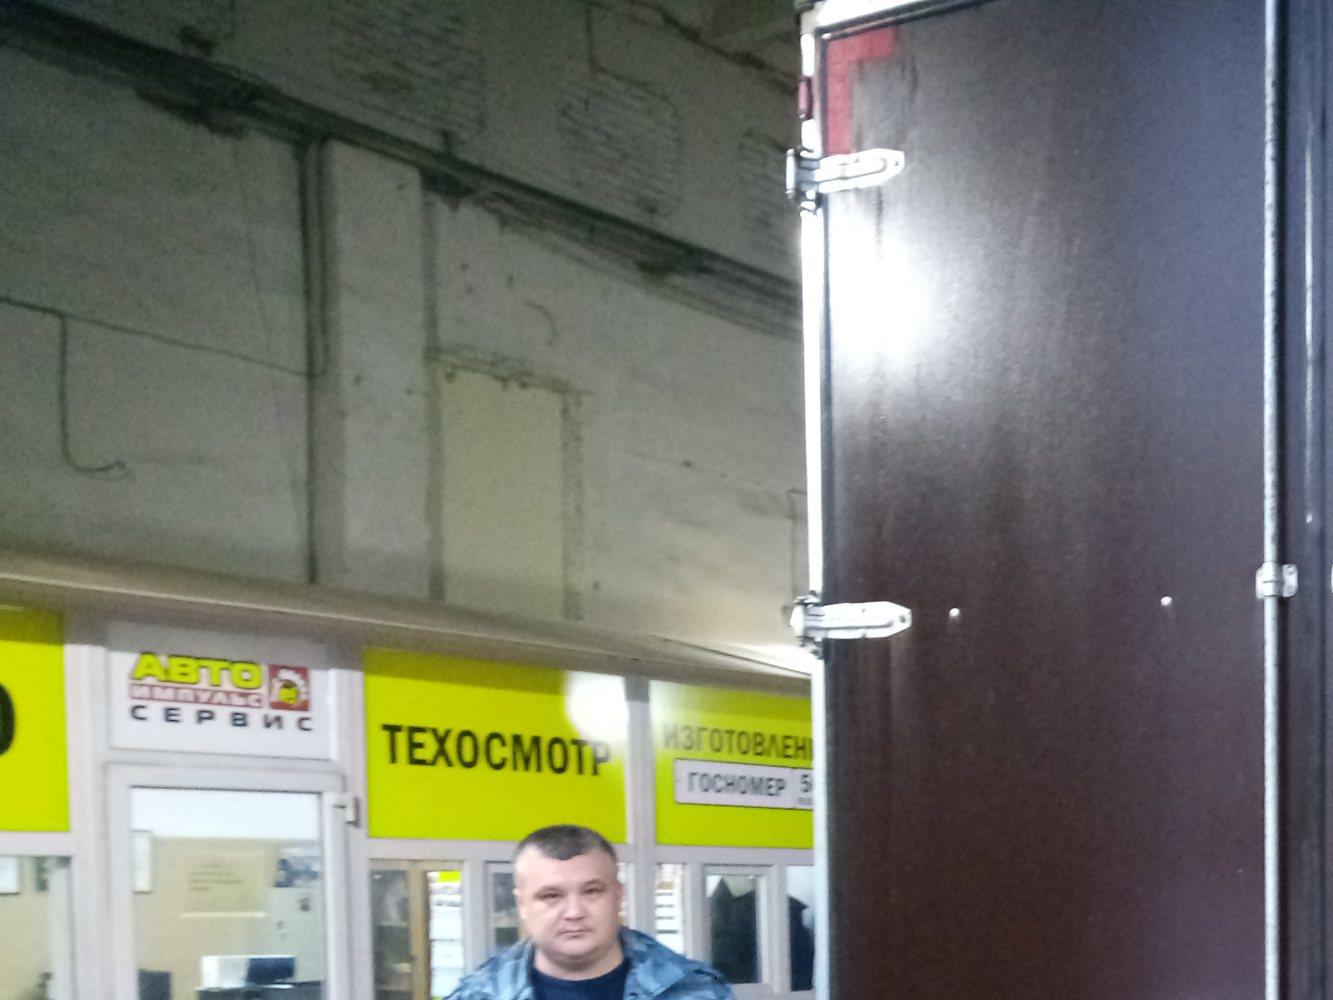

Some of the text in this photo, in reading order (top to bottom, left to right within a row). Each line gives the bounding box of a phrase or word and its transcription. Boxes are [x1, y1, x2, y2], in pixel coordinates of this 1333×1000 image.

[131, 652, 262, 689] АВТО
[131, 705, 312, 731] СЕРВИС
[381, 724, 611, 776] ТЕХОСМОТР
[663, 724, 812, 761] ИЗГОТОВЛЕН
[688, 772, 787, 796] ГОСНОМЕР
